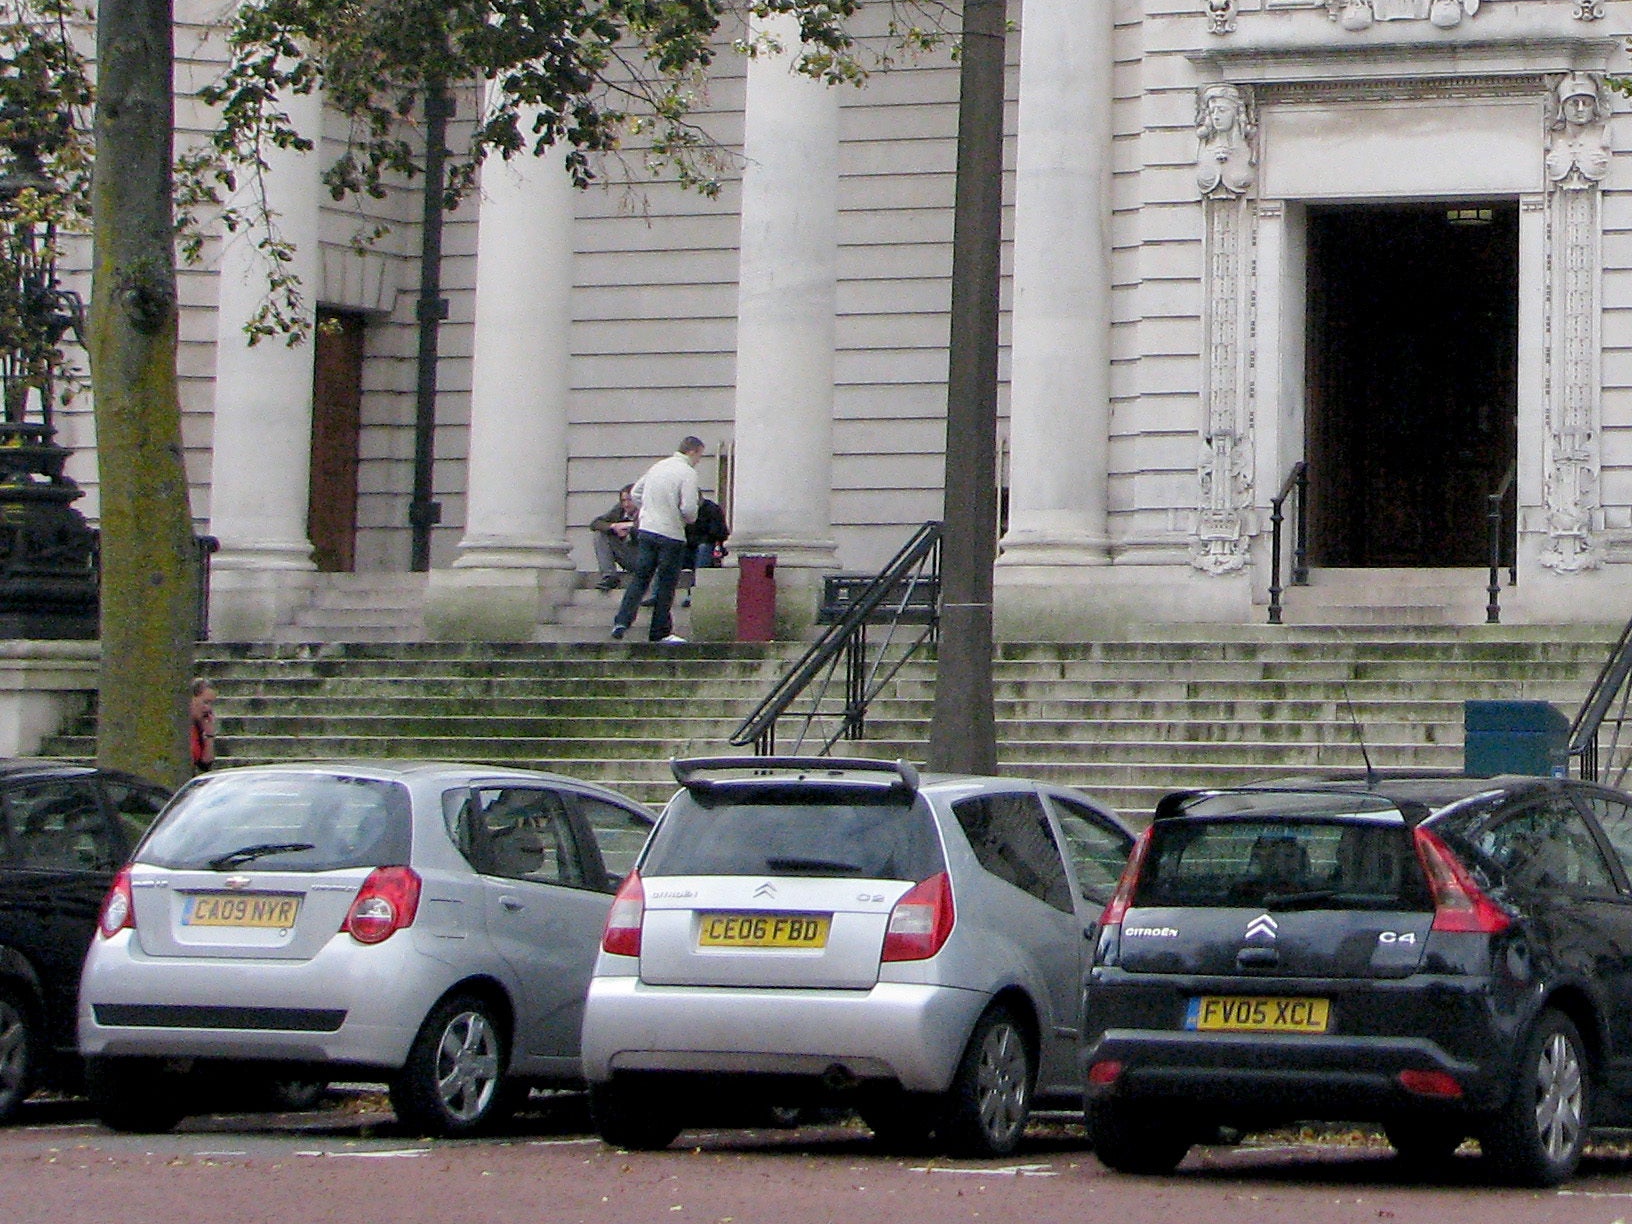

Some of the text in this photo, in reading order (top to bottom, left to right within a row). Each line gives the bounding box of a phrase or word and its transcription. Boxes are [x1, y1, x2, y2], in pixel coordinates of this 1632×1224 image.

[194, 899, 292, 923] CA09 NYR
[708, 918, 818, 942] CE06 FBD
[1379, 931, 1416, 945] C4
[1203, 999, 1322, 1026] FV05 XCL
